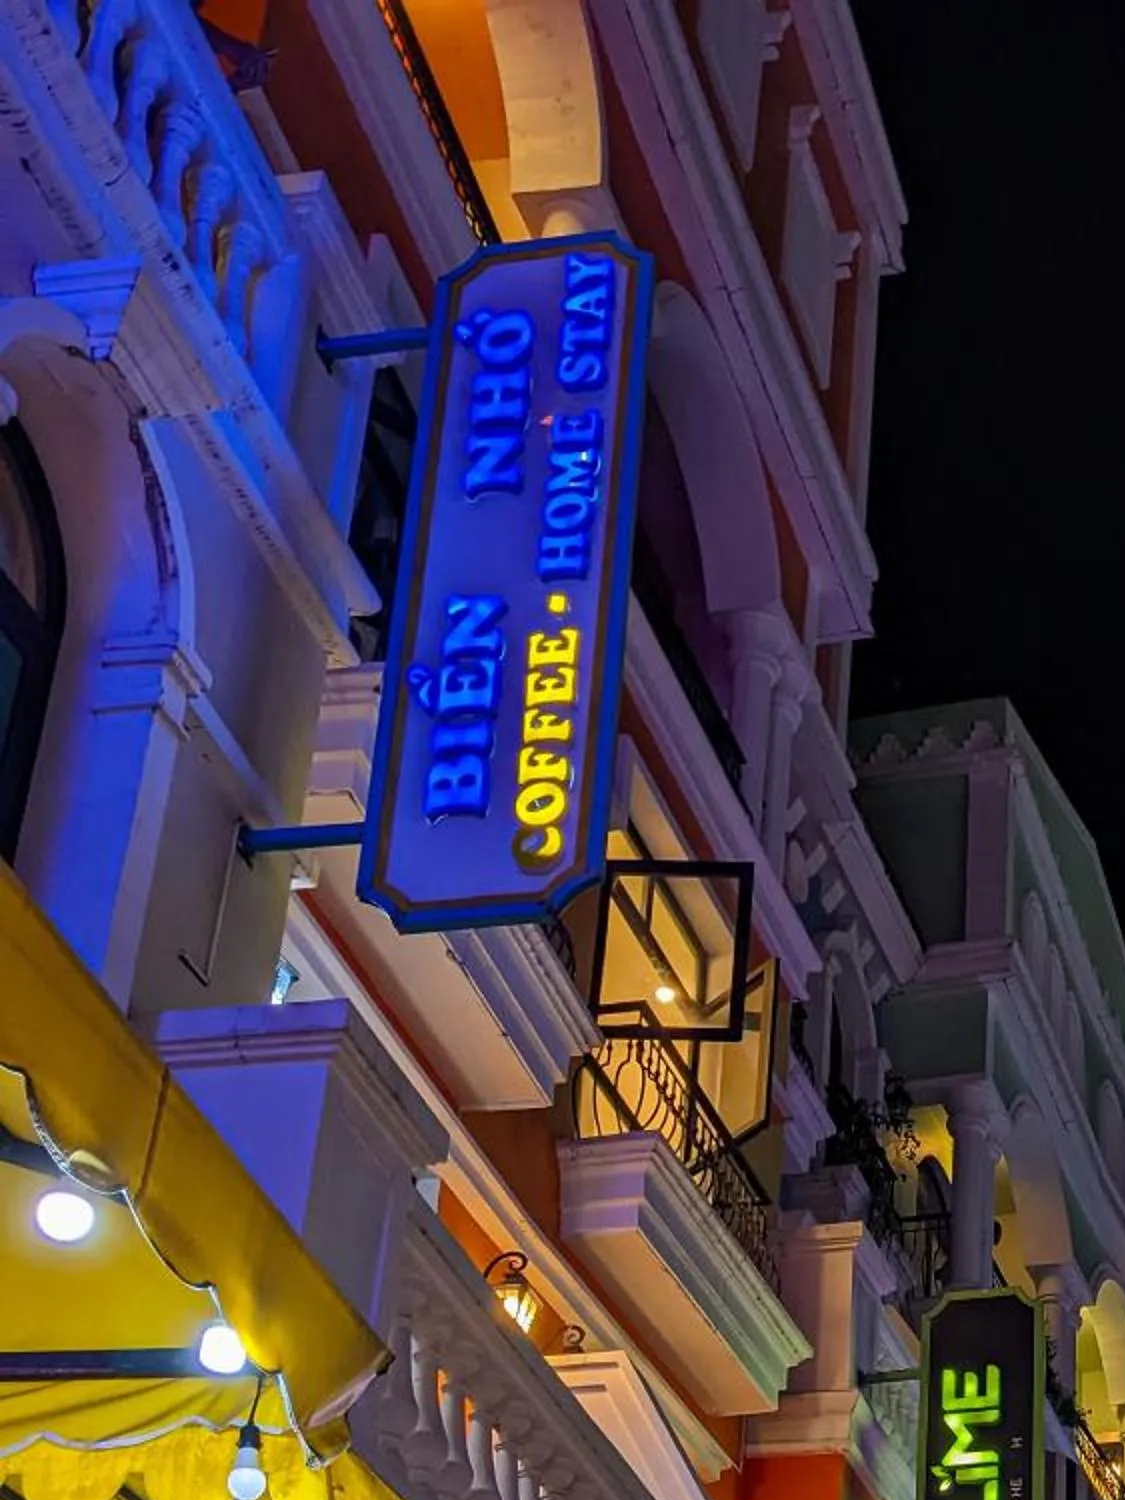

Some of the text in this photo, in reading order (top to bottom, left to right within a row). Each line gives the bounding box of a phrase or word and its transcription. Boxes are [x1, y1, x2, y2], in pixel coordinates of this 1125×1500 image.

[513, 253, 616, 872] COFFEE HOME STAY
